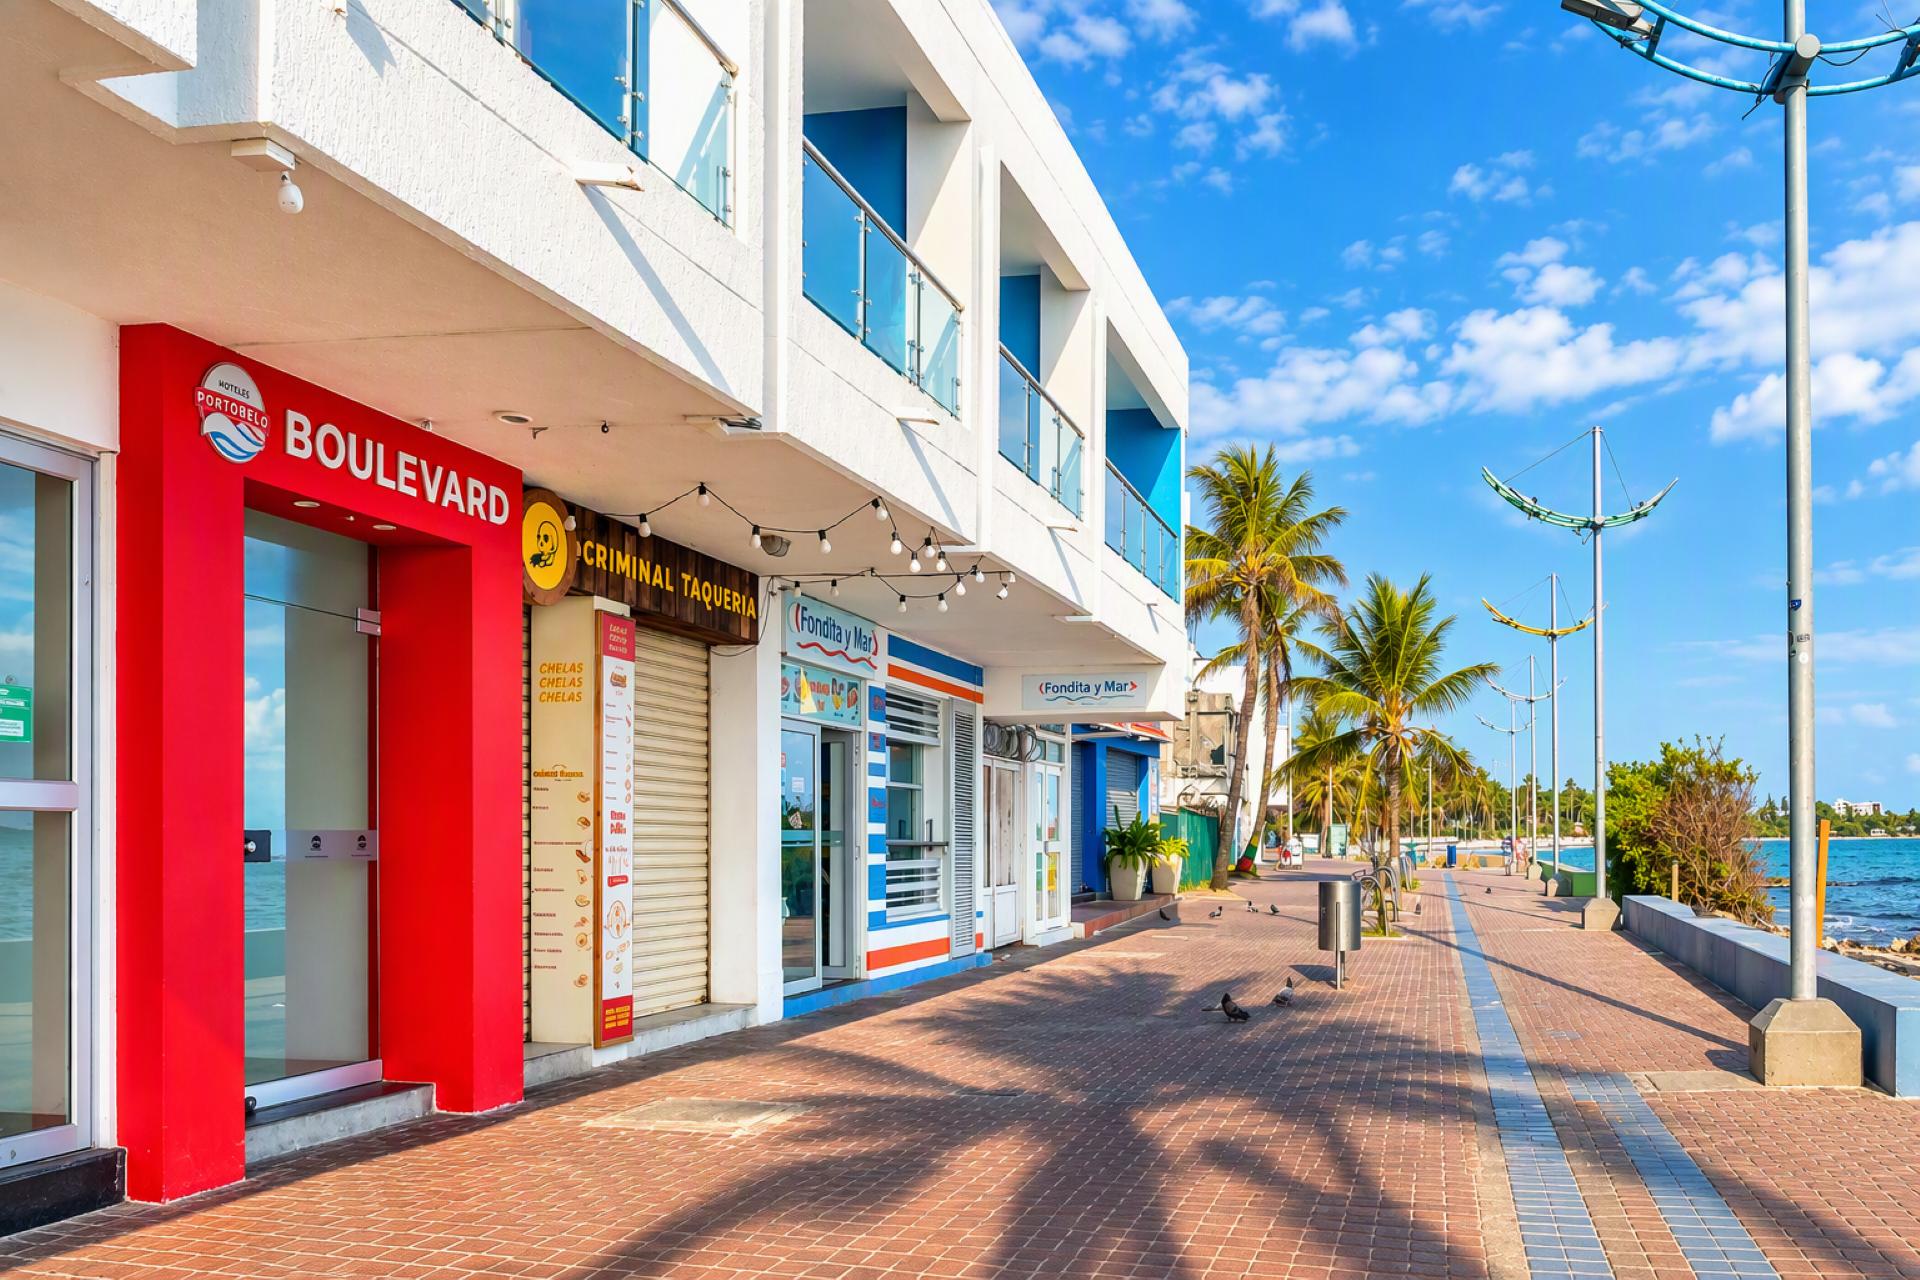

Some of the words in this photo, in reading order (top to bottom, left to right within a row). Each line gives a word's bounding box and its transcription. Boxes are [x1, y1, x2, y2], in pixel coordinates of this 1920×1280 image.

[218, 379, 250, 399] HOTELES
[197, 390, 268, 428] PORTOBELO
[285, 409, 510, 525] BOULEVARD
[681, 573, 757, 620] TAQUERIA
[801, 605, 842, 643] Fondita
[845, 629, 852, 651] y
[854, 626, 872, 653] Mar
[539, 661, 584, 674] CHELAS
[539, 676, 583, 688] CHELAS
[1045, 681, 1090, 694] Fondita
[1094, 683, 1101, 696] y
[1104, 680, 1129, 692] Mar
[538, 691, 583, 703] CHELAS
